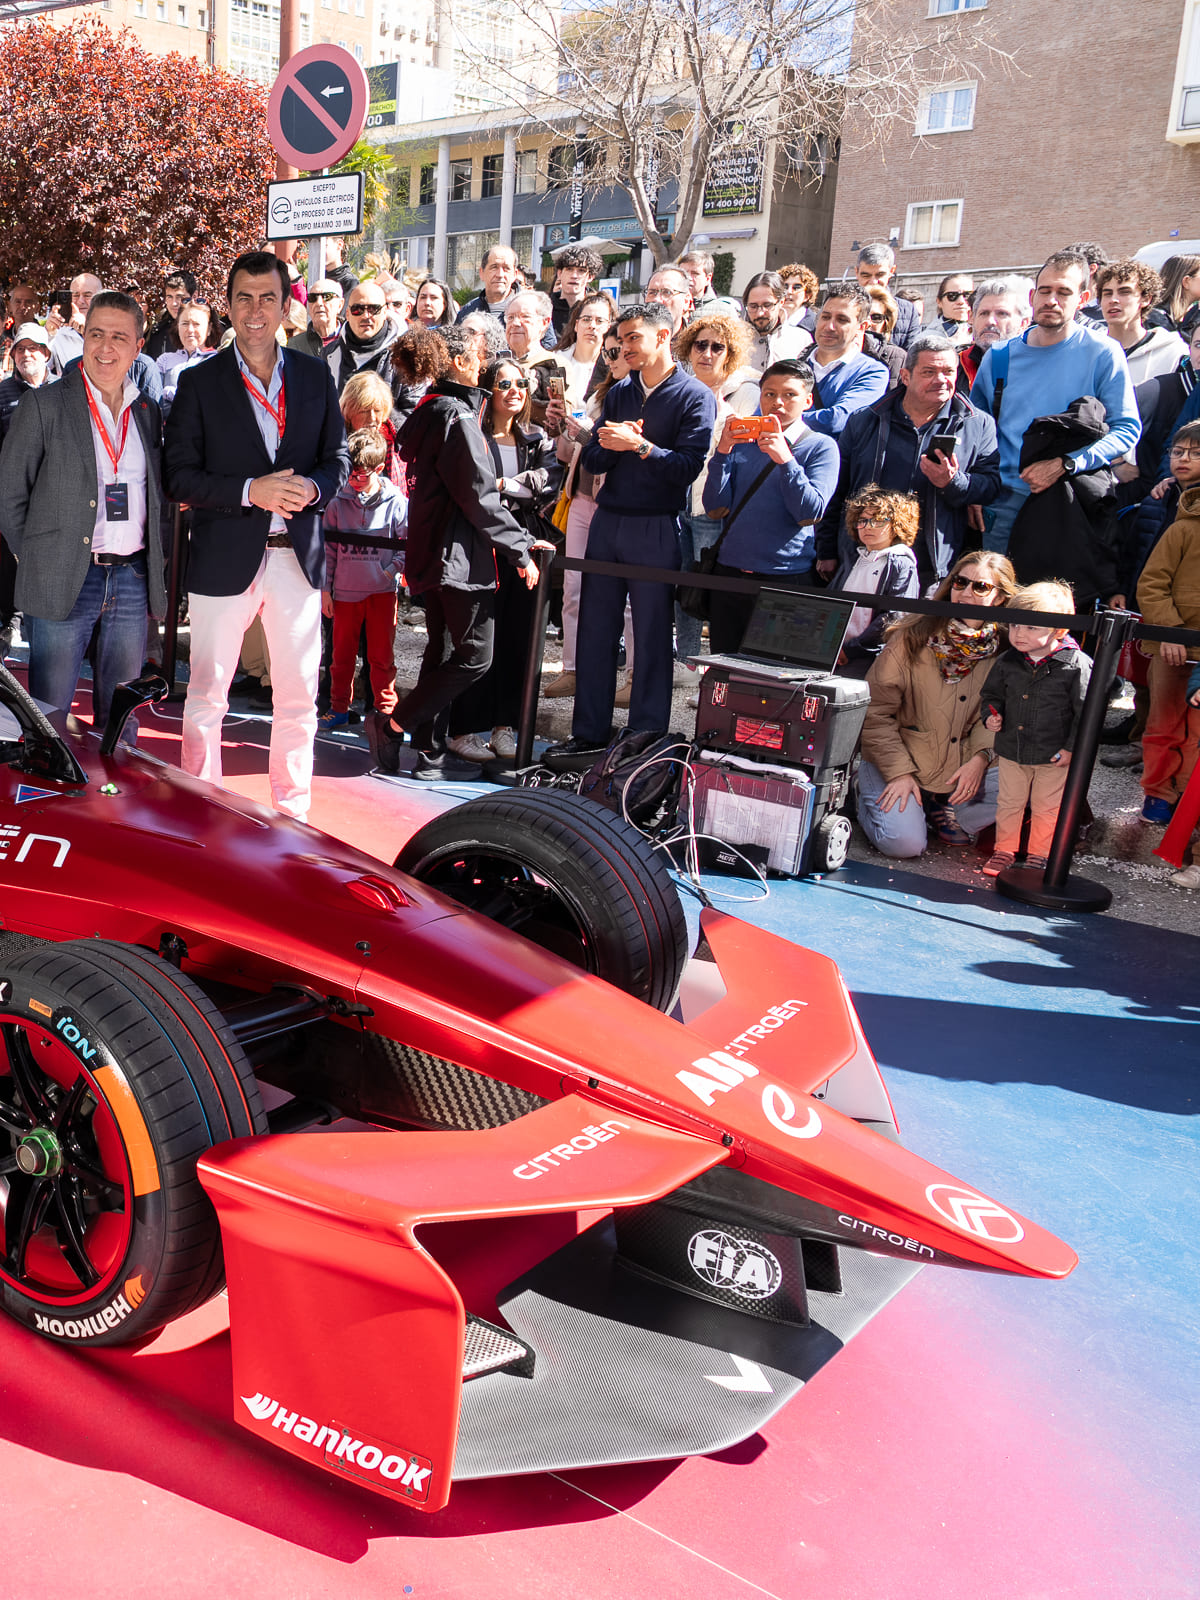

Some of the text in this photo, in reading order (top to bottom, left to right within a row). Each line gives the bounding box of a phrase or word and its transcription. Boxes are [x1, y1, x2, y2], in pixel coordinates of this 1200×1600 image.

[313, 183, 335, 192] EXCEPTO
[293, 206, 354, 219] EN PROCESO DE CARGA
[293, 222, 311, 231] TIEMPO
[724, 998, 809, 1058] ITROËN
[675, 1050, 760, 1107] ABB
